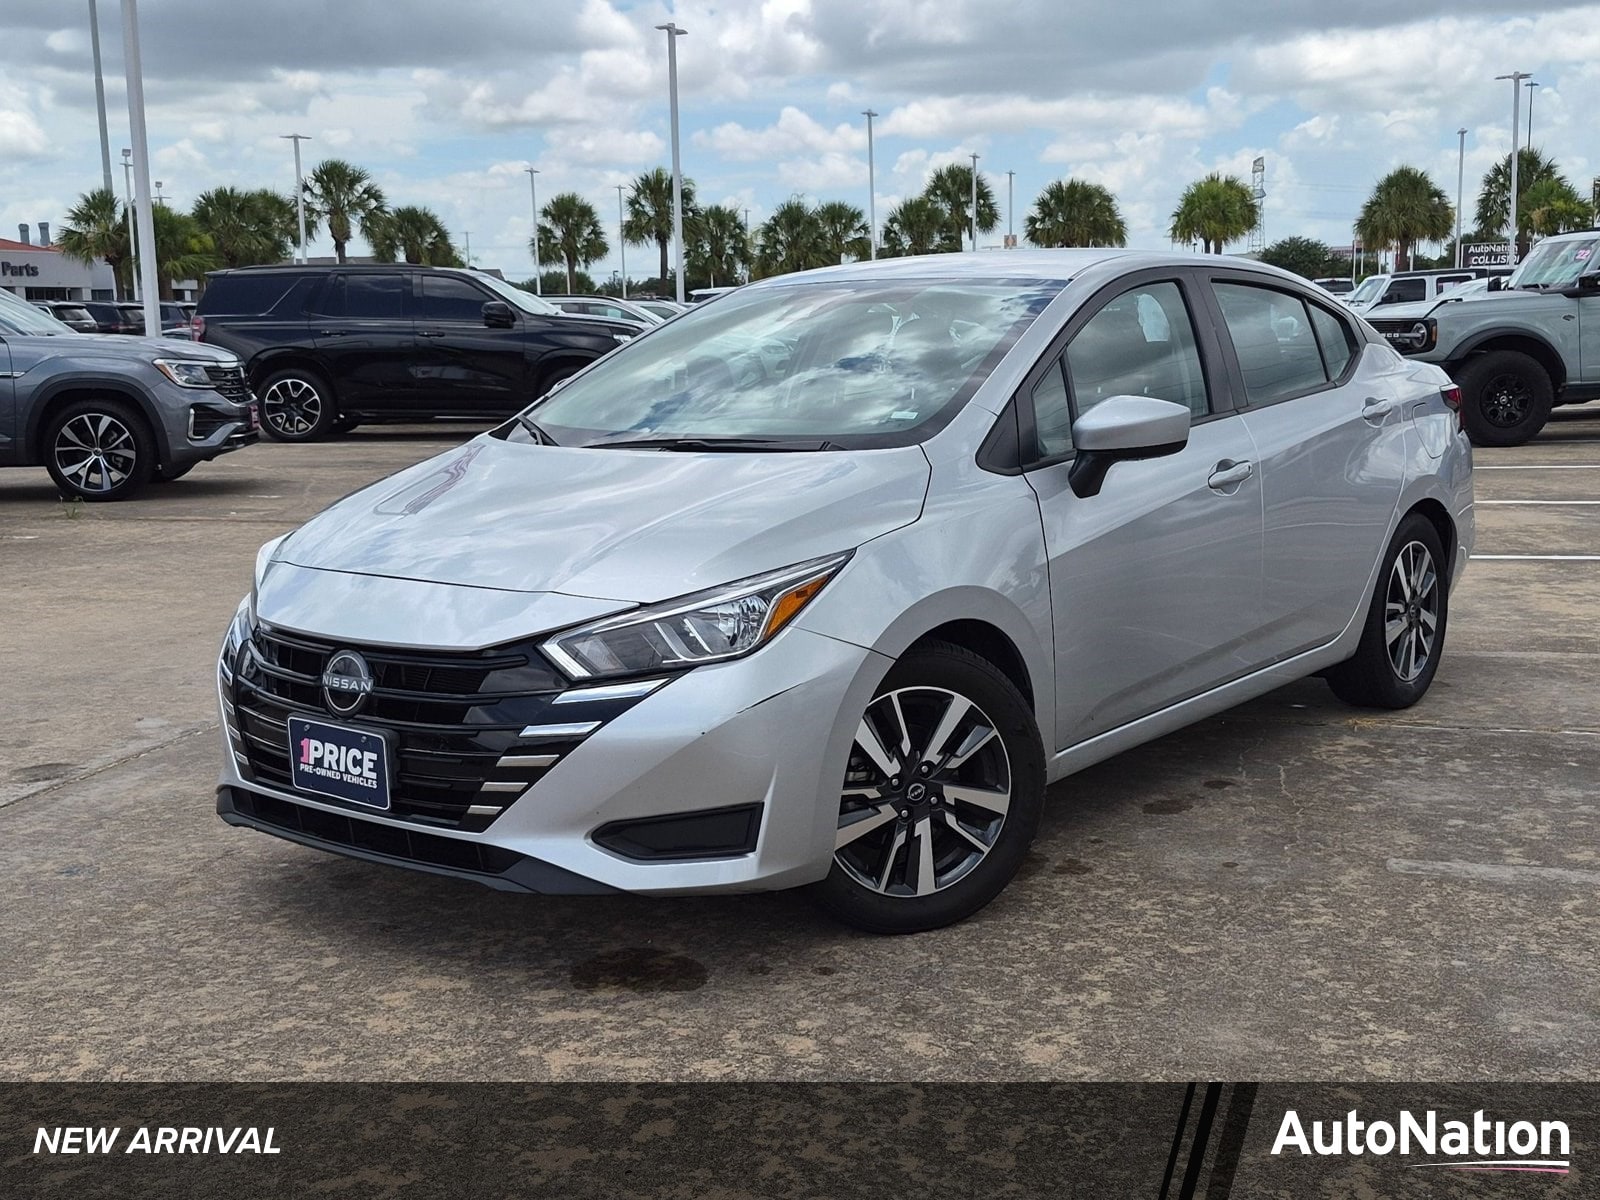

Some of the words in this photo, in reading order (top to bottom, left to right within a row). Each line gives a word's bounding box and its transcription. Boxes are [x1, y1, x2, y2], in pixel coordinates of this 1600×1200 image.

[1468, 243, 1519, 254] AutoNatin
[1472, 254, 1520, 265] COLLIS
[1, 261, 39, 277] Parts
[322, 674, 372, 692] NISSAN
[300, 763, 341, 780] PRE-OWNED
[342, 773, 378, 789] VEHICLES
